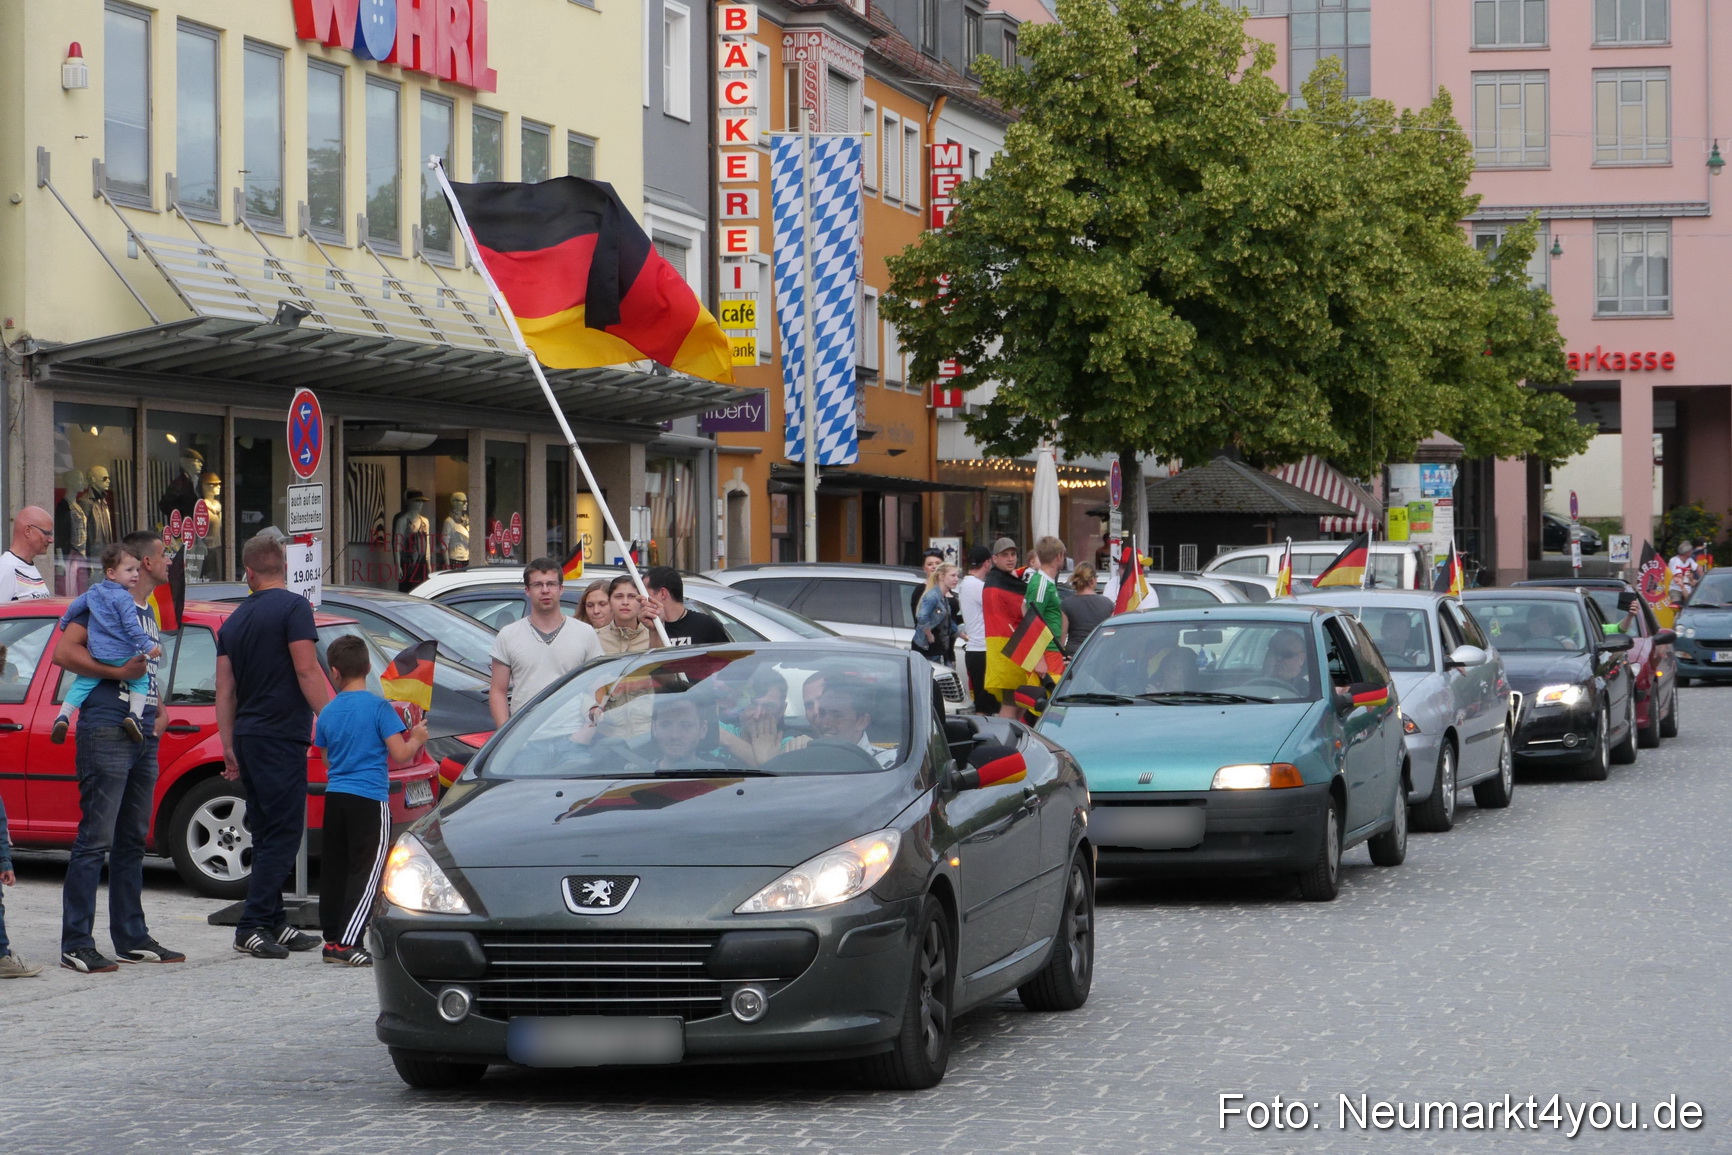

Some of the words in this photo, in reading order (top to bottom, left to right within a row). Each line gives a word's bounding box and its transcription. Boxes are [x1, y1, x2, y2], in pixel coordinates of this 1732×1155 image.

[724, 8, 749, 290] BÄCKEREI
[722, 303, 755, 323] café
[732, 342, 755, 358] ank
[1567, 344, 1676, 372] arkasse
[291, 494, 302, 507] auch
[303, 494, 311, 506] auf
[311, 492, 321, 504] dem
[291, 510, 322, 525] Seitenstreifen
[305, 551, 314, 563] ab
